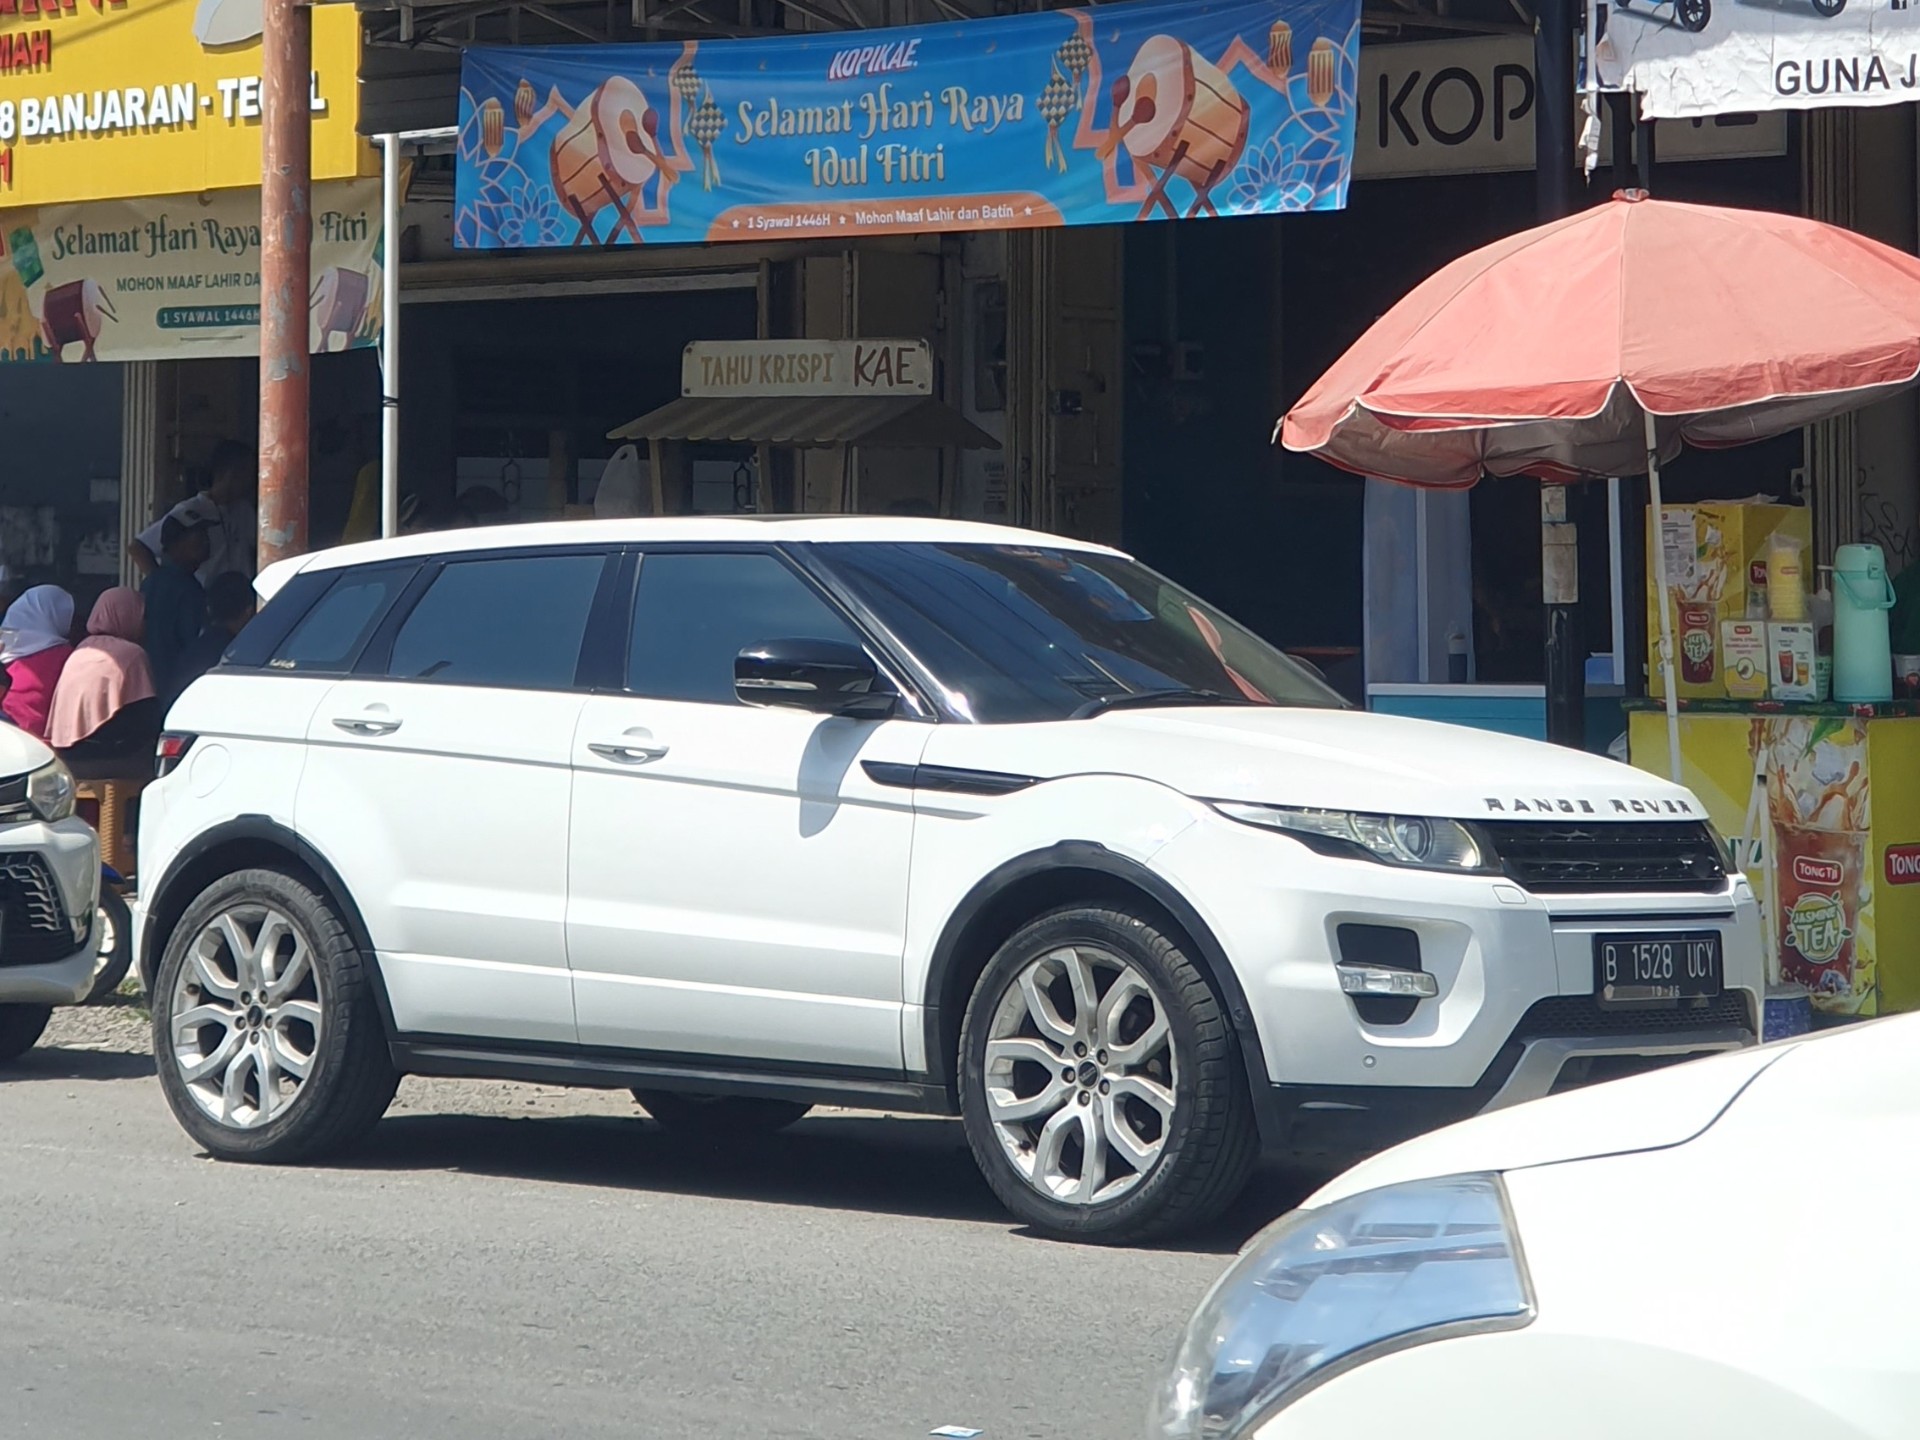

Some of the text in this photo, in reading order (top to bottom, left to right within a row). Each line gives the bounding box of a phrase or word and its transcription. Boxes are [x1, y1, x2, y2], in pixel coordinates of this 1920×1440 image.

[1775, 55, 1890, 96] GUNA
[20, 82, 196, 137] BANJARAN
[217, 70, 326, 119] TEL
[736, 82, 1024, 144] Selamat Hari Raya
[1378, 64, 1535, 148] KOP
[804, 143, 945, 187] Idul Fitri
[747, 214, 831, 231] 1 Syawal 1446H
[855, 204, 1013, 225] Mohon Maaf Lahir dan Batin
[52, 211, 368, 260] Selamat Hari Raya Fitri
[116, 271, 261, 292] MOHON MAAF LAHIR DA
[163, 313, 169, 324] 1
[173, 311, 220, 324] SYAWAL
[701, 344, 916, 387] TAHU KRISPI KAE
[1483, 797, 1692, 814] RANGE ROVER
[1799, 863, 1825, 878] TONG
[1796, 920, 1839, 952] TEA
[1605, 942, 1714, 982] B 1528 UCY
